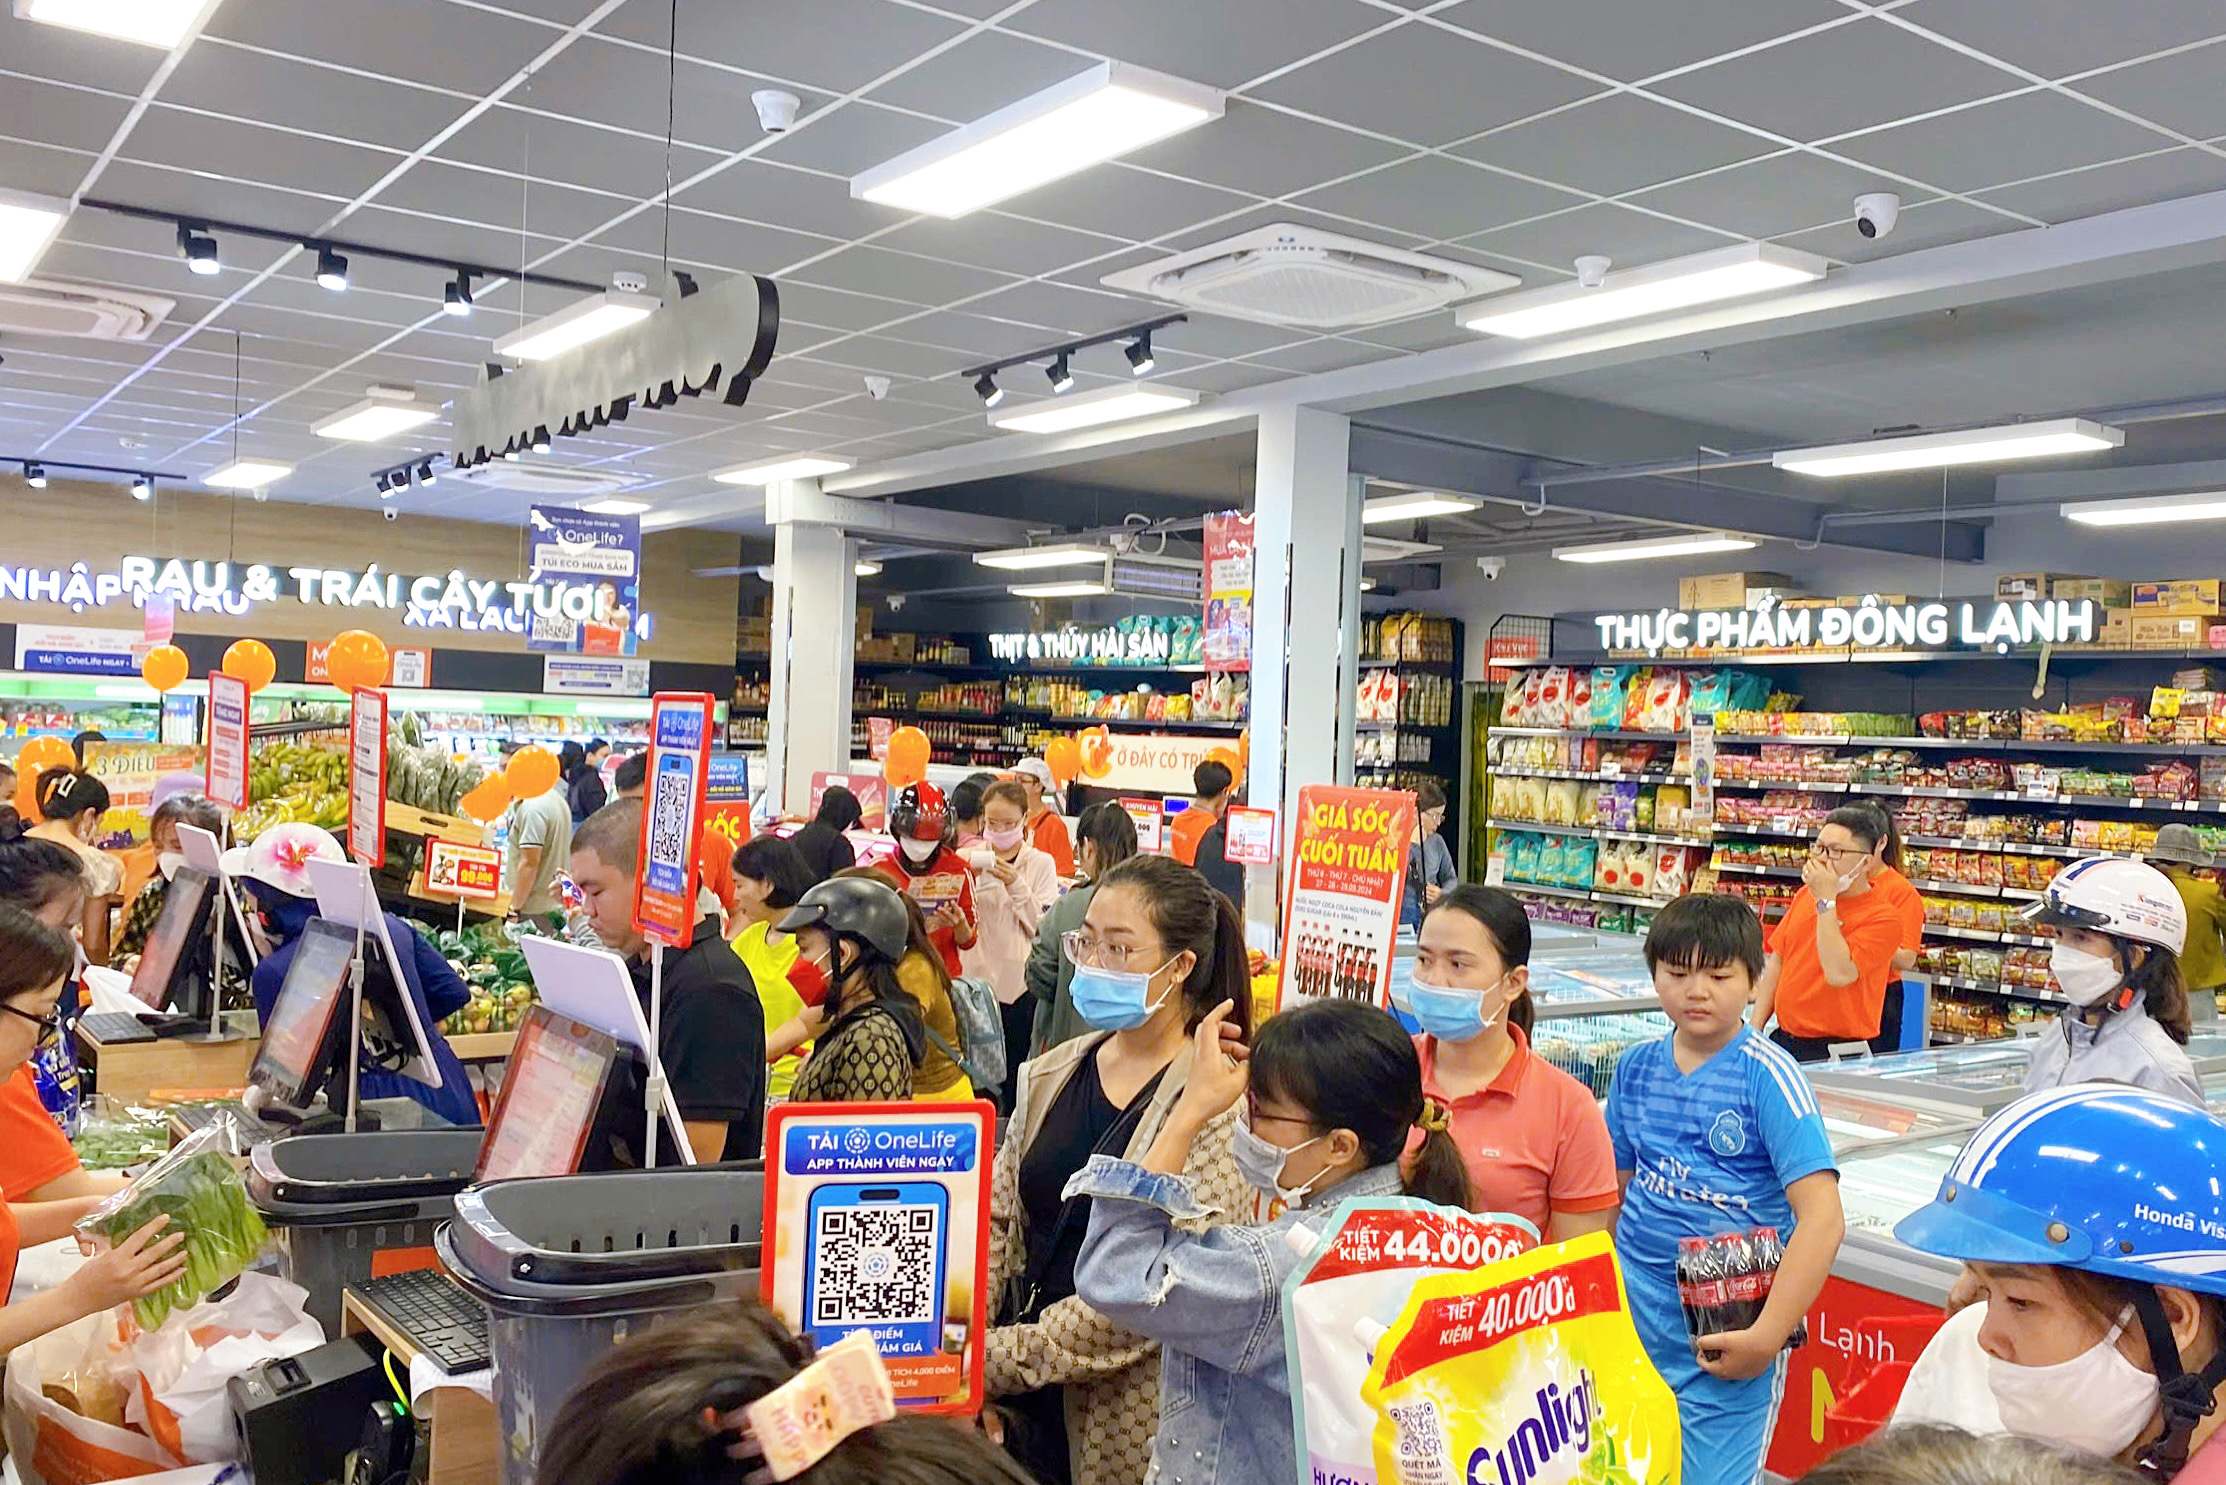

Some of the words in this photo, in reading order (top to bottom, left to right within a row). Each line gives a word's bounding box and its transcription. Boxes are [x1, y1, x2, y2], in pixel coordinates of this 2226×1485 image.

[121, 556, 228, 598] RAU
[243, 564, 277, 602] &
[288, 563, 398, 609] TRÁI
[410, 569, 497, 614] CÂY
[1595, 608, 1689, 658] THỰC
[1697, 595, 1810, 648] PHẨM
[1819, 594, 1948, 646] ĐÔNG
[1961, 599, 2093, 655] LẠNH
[989, 633, 1025, 664] THỊT
[1027, 634, 1041, 659] &
[1092, 626, 1124, 659] HẢI
[1128, 626, 1168, 659] SẢN
[1130, 746, 1156, 768] ĐÂY
[1160, 747, 1178, 769] CÓ
[1314, 799, 1348, 830] GIÁ
[1351, 799, 1390, 836] SỐC
[1300, 832, 1344, 866] CUỐI
[1347, 837, 1399, 873] TUẦN
[1322, 899, 1335, 909] COCA
[1336, 902, 1349, 912] COLA
[807, 1131, 839, 1150] TẢI
[874, 1131, 956, 1150] OneLife
[807, 1158, 834, 1170] APP
[837, 1155, 883, 1170] THÀNH
[884, 1154, 916, 1169] VIÊN
[918, 1156, 955, 1168] NGAY
[2134, 1203, 2194, 1232] Honda
[2199, 1218, 2226, 1241] Vis
[1343, 1224, 1380, 1245] TIẾT
[1340, 1245, 1380, 1265] KIỆM
[1447, 1295, 1475, 1322] TIẾT
[873, 1326, 903, 1340] ĐIỂM
[1439, 1323, 1474, 1346] KIỆM
[1820, 1311, 1895, 1363] Lạnh
[902, 1340, 923, 1353] GIÁ
[890, 1379, 918, 1388] neLife
[1401, 1459, 1424, 1469] QUÉT
[1426, 1459, 1442, 1469] MÃ
[1424, 1471, 1443, 1481] NGAY
